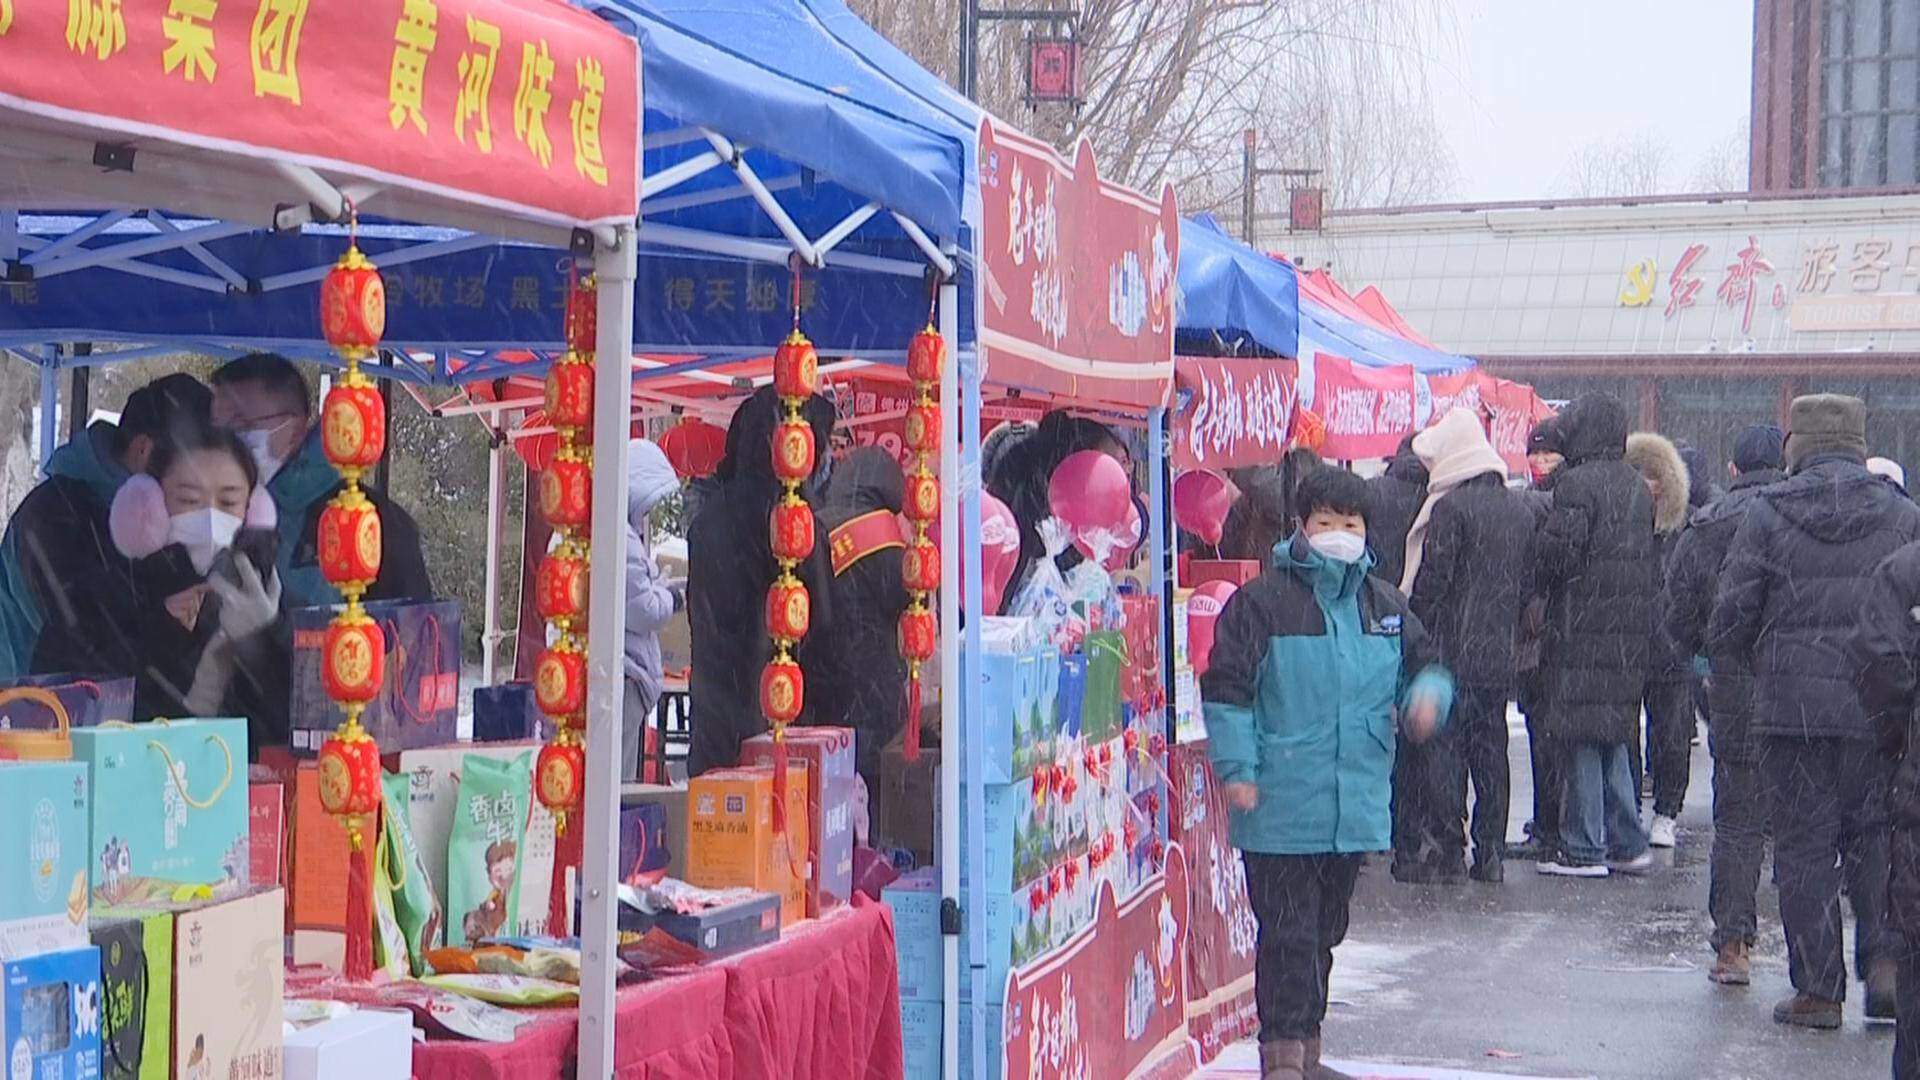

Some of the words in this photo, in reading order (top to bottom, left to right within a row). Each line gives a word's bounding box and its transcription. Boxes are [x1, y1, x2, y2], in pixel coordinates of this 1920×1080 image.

[389, 0, 608, 187] 黄河味道
[469, 789, 517, 824] 香卤
